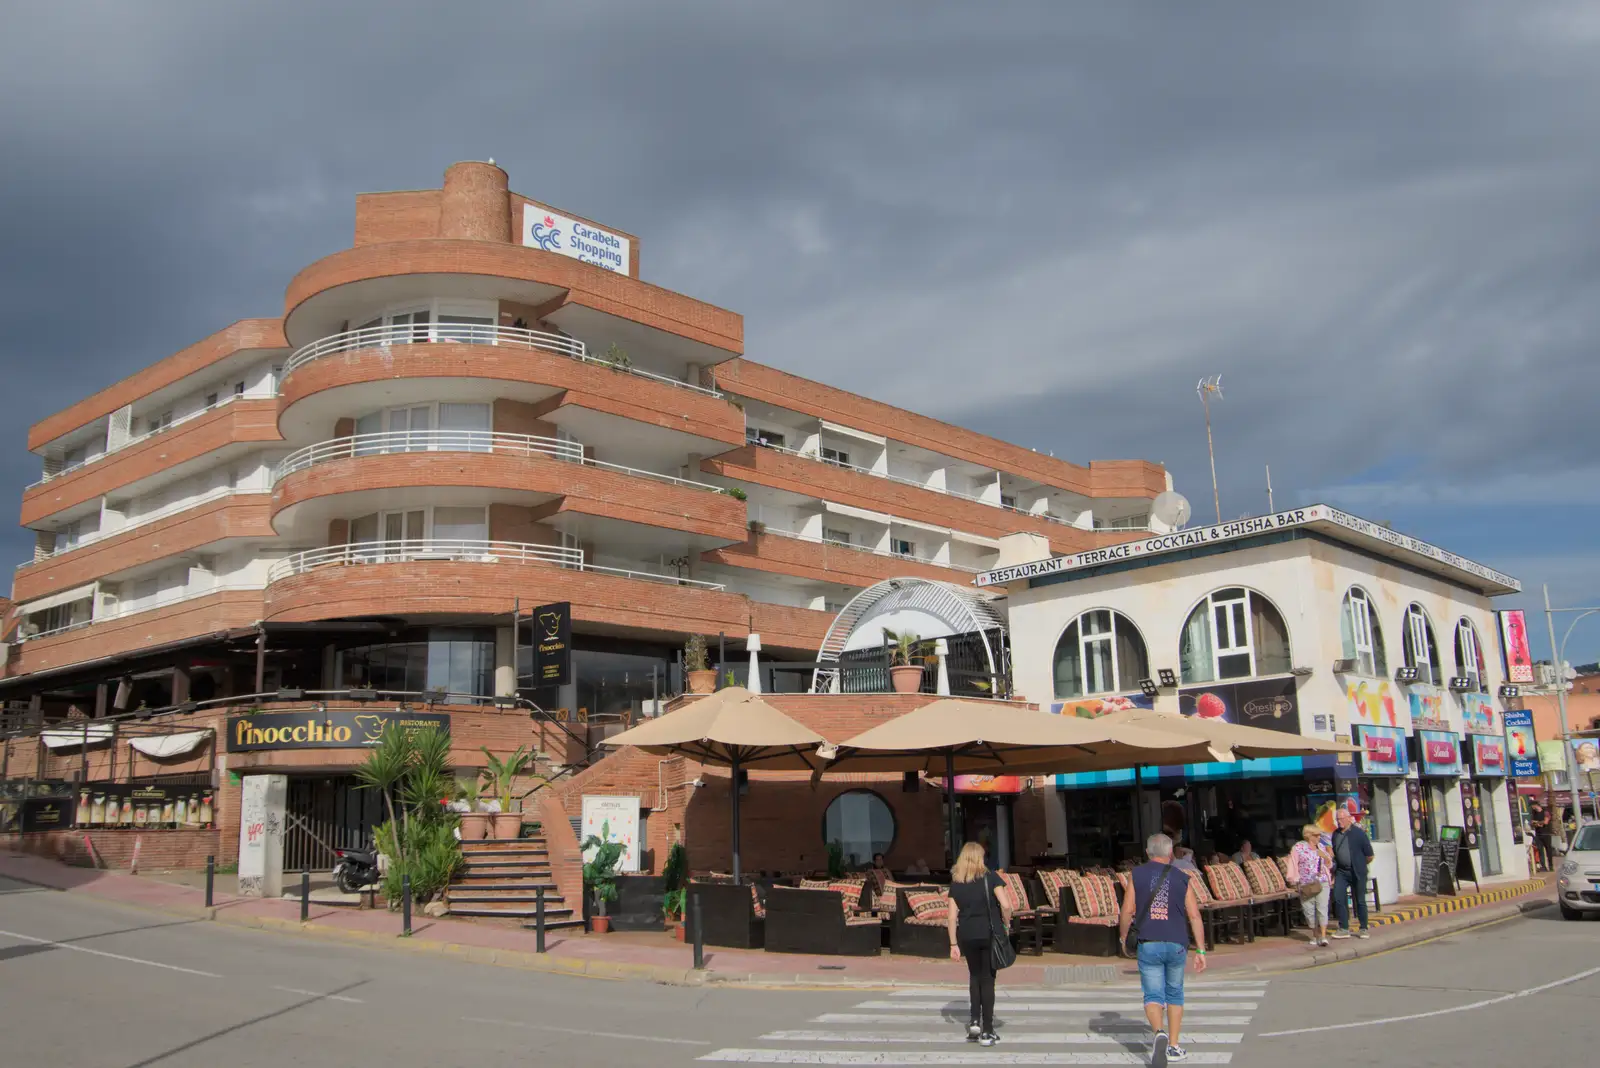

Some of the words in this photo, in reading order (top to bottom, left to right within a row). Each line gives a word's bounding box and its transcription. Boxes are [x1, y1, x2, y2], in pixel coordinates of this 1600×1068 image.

[573, 223, 620, 249] Carabela
[570, 236, 622, 266] Shopping
[1331, 509, 1371, 534] RESTAURANT
[1377, 527, 1404, 545] PIZZERIA
[990, 558, 1063, 583] RESTAURANT
[1077, 545, 1130, 565] TERRACE
[1146, 531, 1207, 552] COCKTAIL
[1211, 528, 1220, 539] &
[1224, 518, 1273, 537] SHISHA
[1277, 510, 1305, 526] BAR
[236, 718, 352, 745] Pinocchio
[399, 719, 441, 727] RISTORANTE
[1515, 761, 1533, 769] Saray
[1515, 768, 1535, 776] Beach
